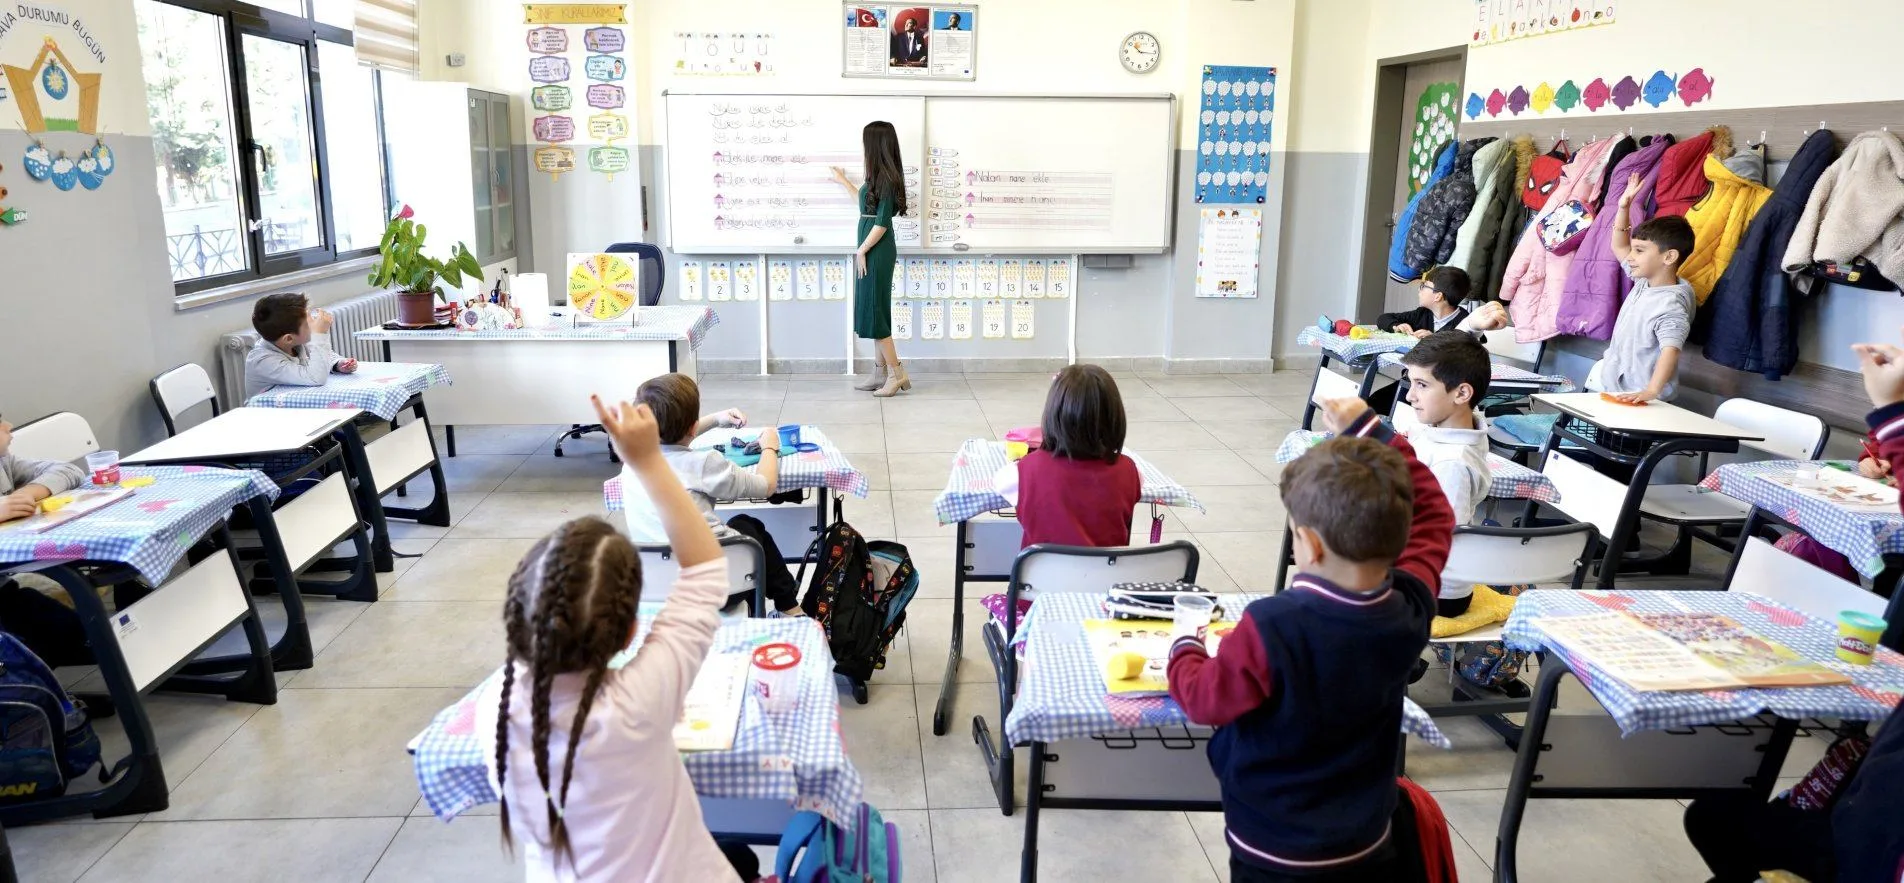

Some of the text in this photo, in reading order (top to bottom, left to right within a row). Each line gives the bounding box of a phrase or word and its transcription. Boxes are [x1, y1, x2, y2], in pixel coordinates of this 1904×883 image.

[0, 5, 106, 64] AVA DURUMU BUGÜN
[716, 285, 723, 295] 2
[743, 284, 750, 294] 3
[777, 285, 784, 293] 4
[805, 284, 812, 293] 5
[831, 284, 837, 293] 6
[914, 282, 921, 291] 9
[936, 282, 946, 291] 10
[961, 282, 968, 291] 11
[983, 282, 992, 291] 12
[1006, 283, 1016, 292] 13
[1029, 283, 1039, 292] 14
[1054, 283, 1063, 292] 15
[896, 324, 906, 333] 16
[929, 323, 937, 332] 17
[956, 323, 965, 332] 18
[990, 323, 999, 332] 19
[1017, 323, 1029, 332] 20
[0, 782, 37, 796] AN
